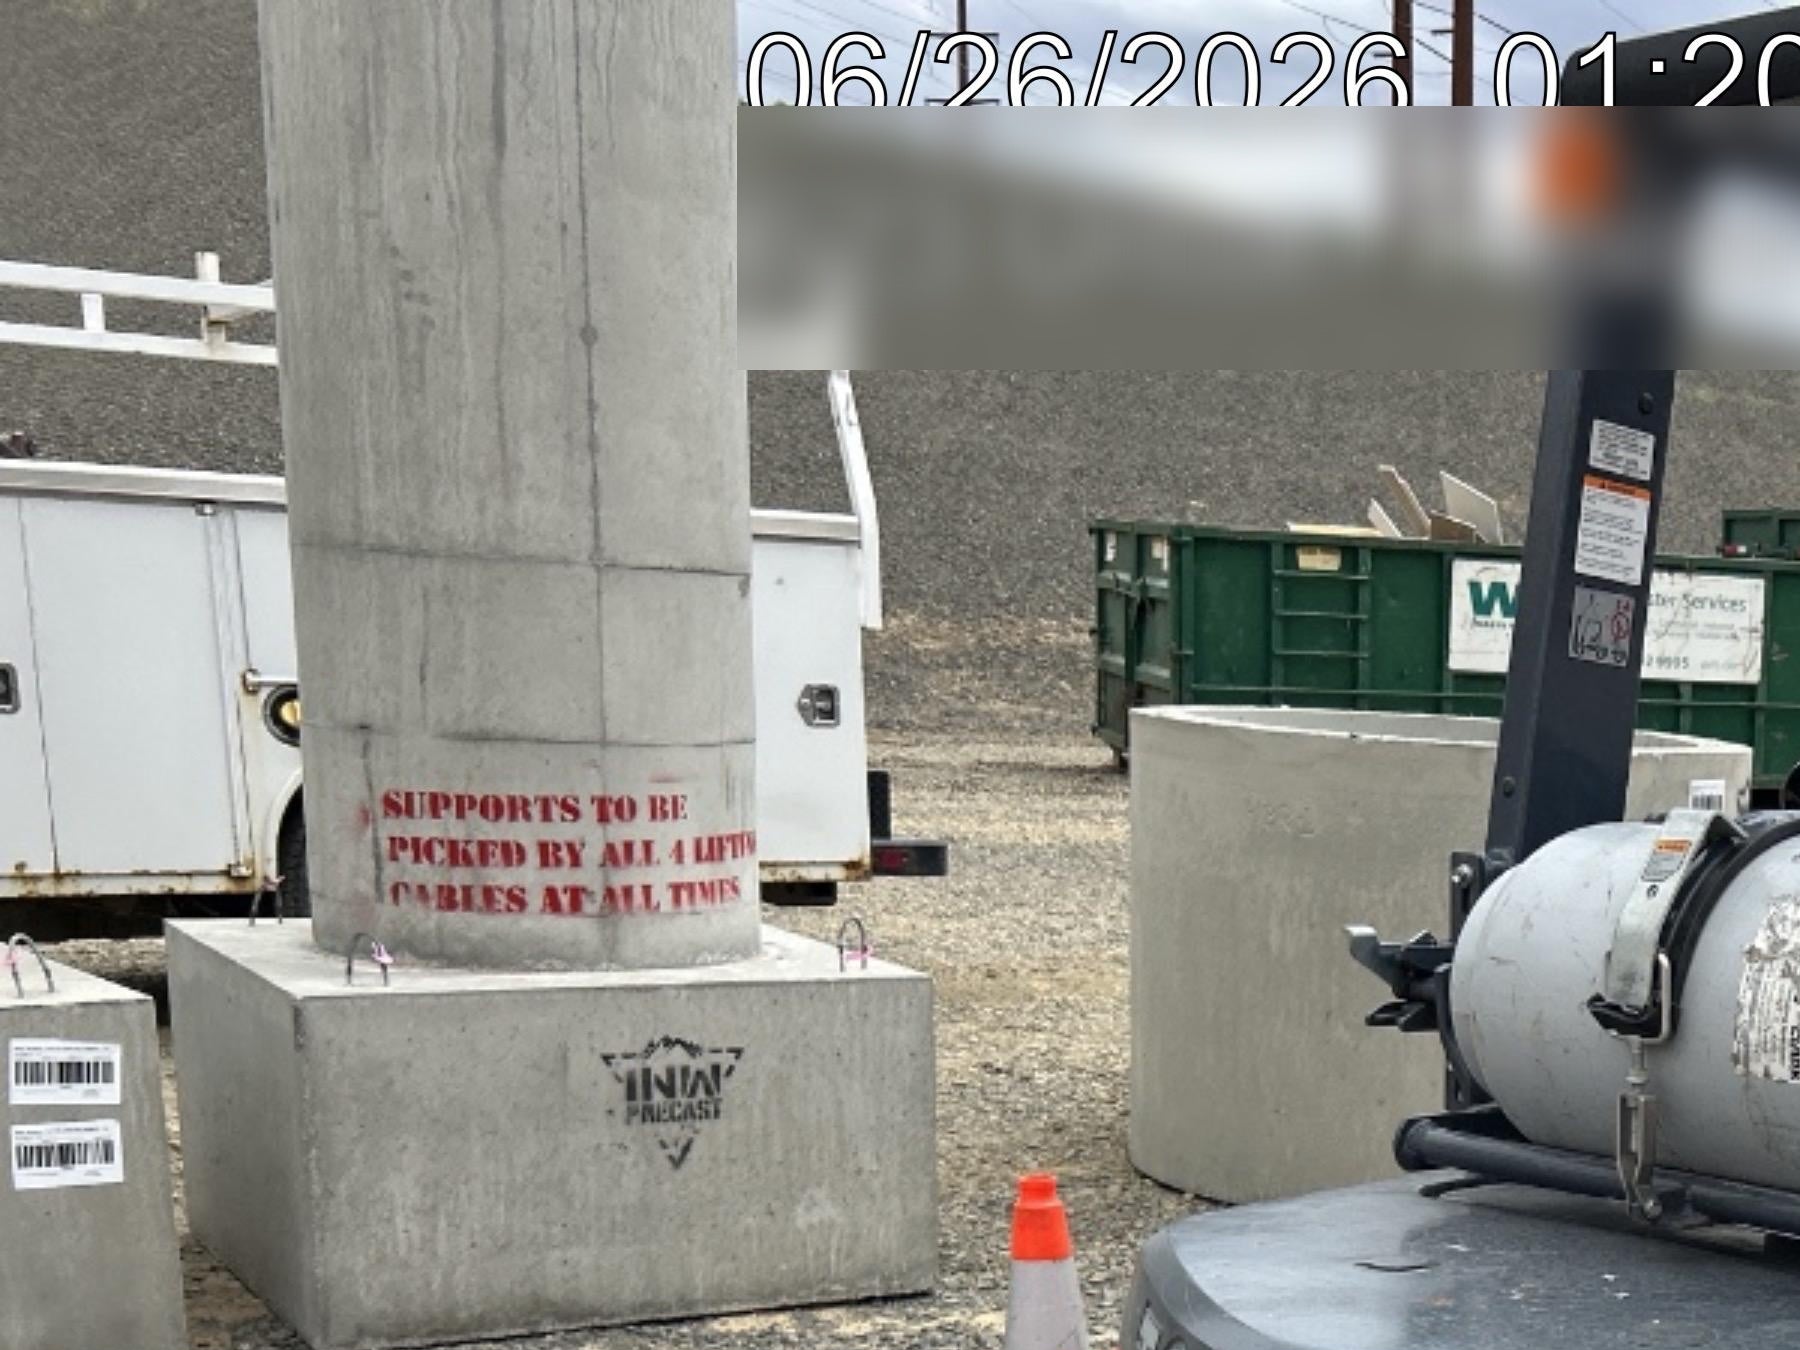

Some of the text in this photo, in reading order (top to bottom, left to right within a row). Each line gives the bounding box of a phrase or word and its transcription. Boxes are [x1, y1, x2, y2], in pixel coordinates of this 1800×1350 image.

[382, 790, 688, 824] SUPPORTS TO BE
[387, 829, 757, 868] PICKED BY ALL 4 LIFTIN
[390, 876, 740, 914] CABLES AT ALL TIMES
